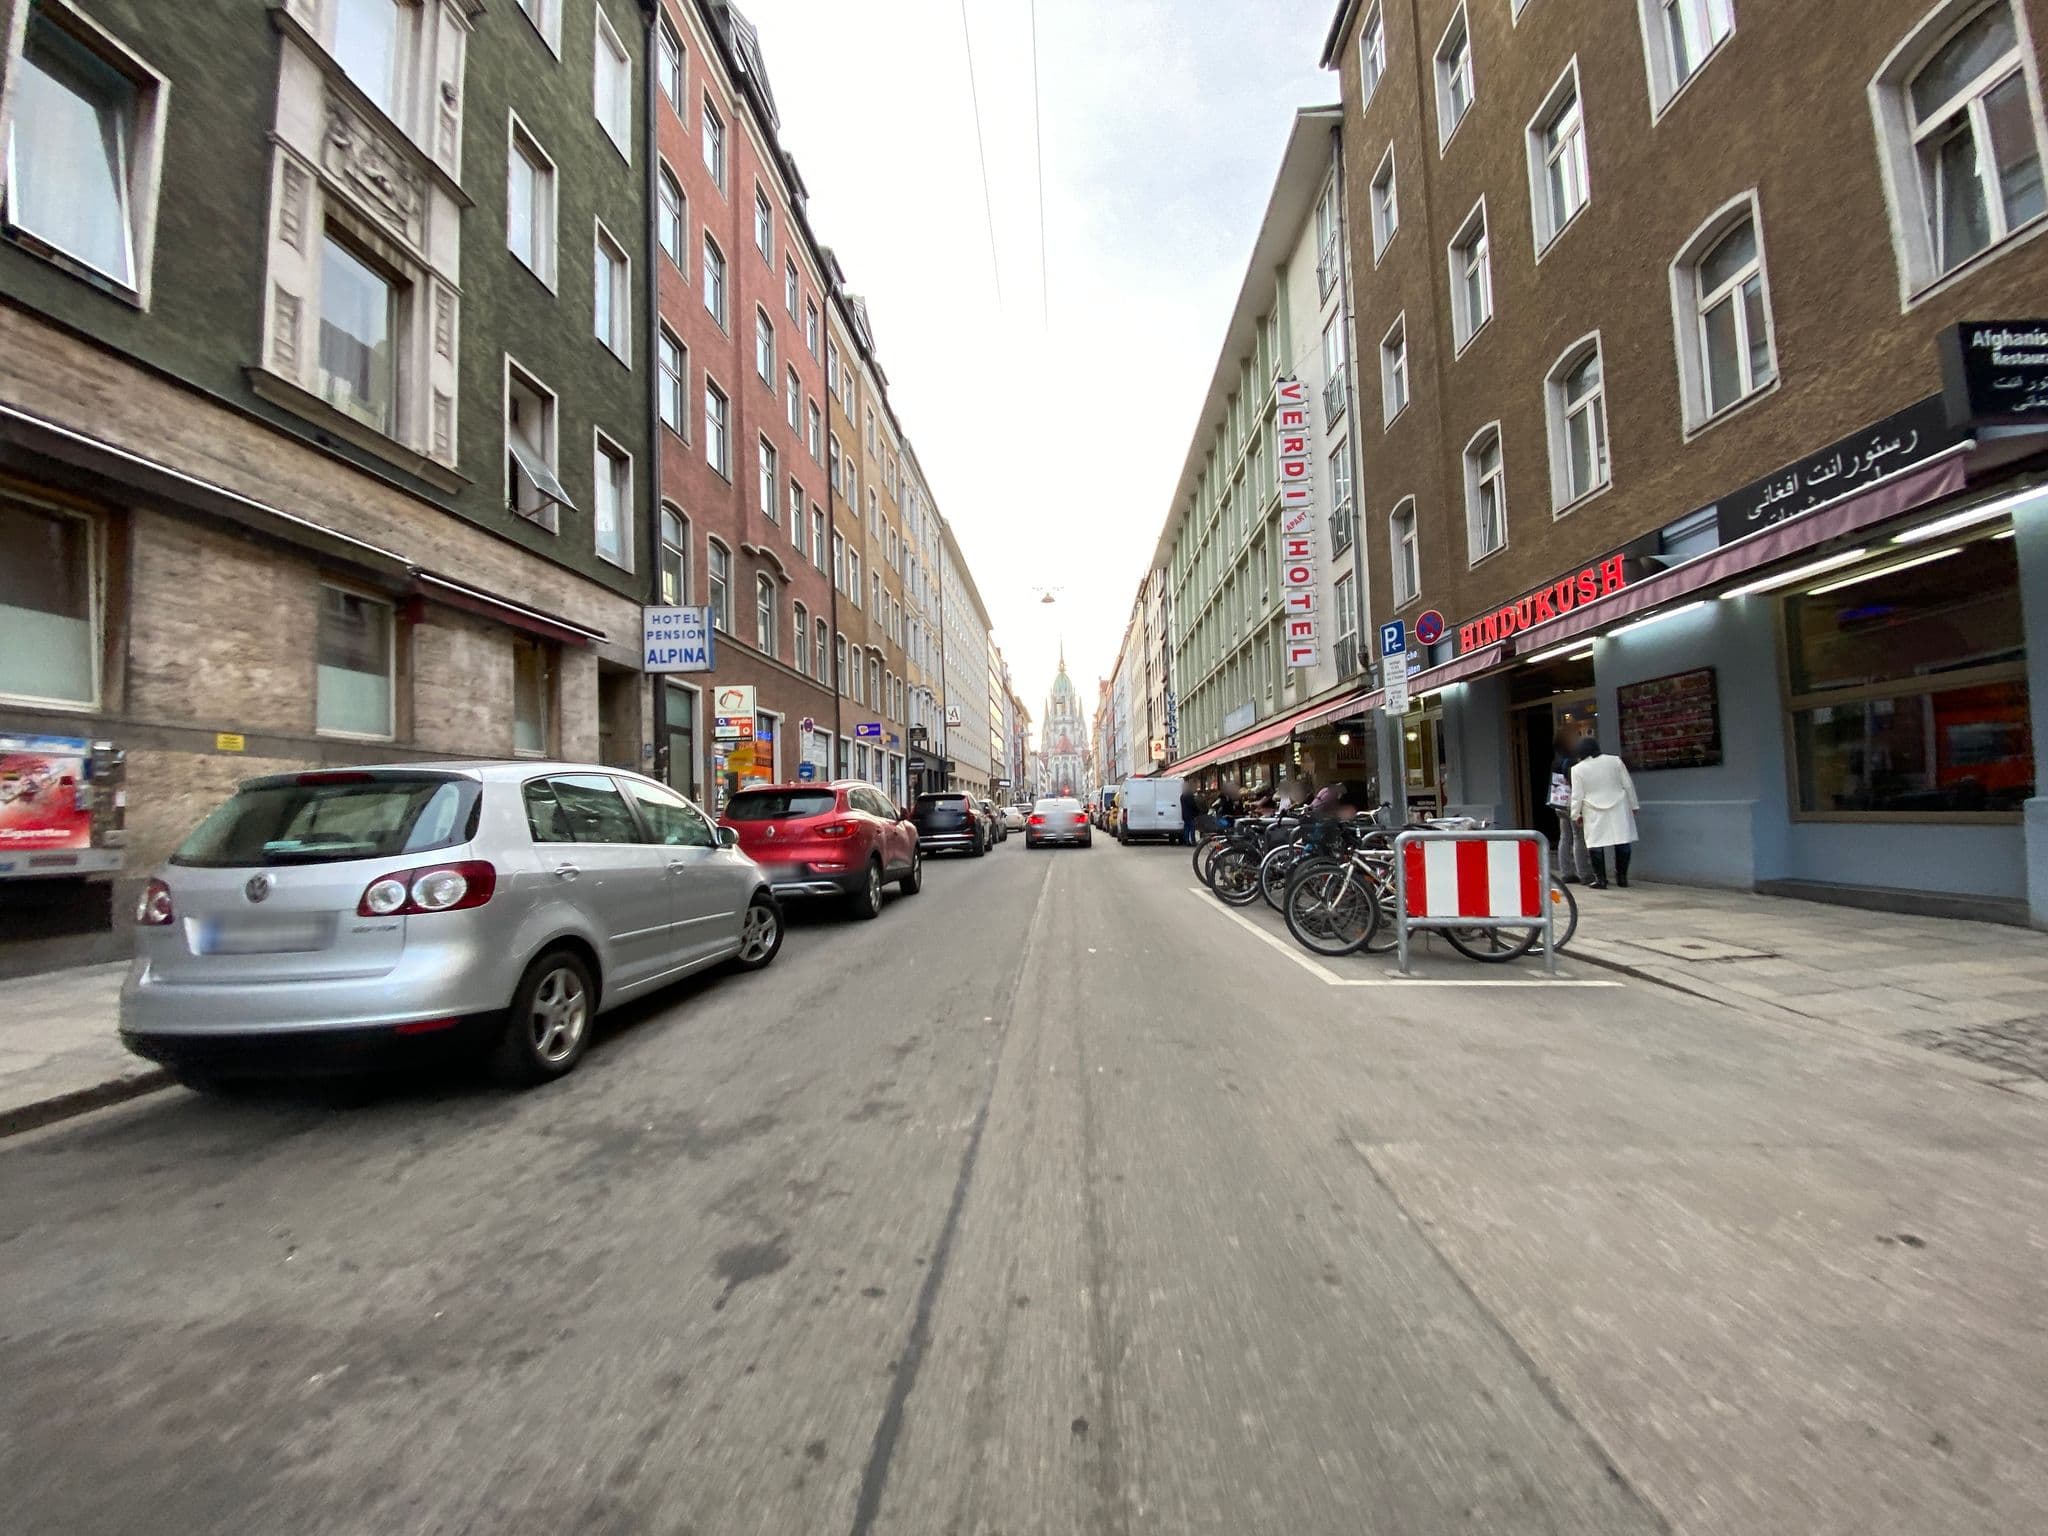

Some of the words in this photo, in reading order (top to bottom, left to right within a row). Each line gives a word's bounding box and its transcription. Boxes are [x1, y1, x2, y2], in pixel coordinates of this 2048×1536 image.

[1281, 384, 1306, 498] VERDI
[1286, 511, 1308, 532] APART
[1288, 540, 1312, 662] HOTEL
[1459, 552, 1627, 655] HINDUKUSH
[652, 614, 700, 624] HOTEL
[646, 629, 706, 641] PENSION
[1384, 626, 1398, 653] P
[647, 647, 707, 665] ALPINA
